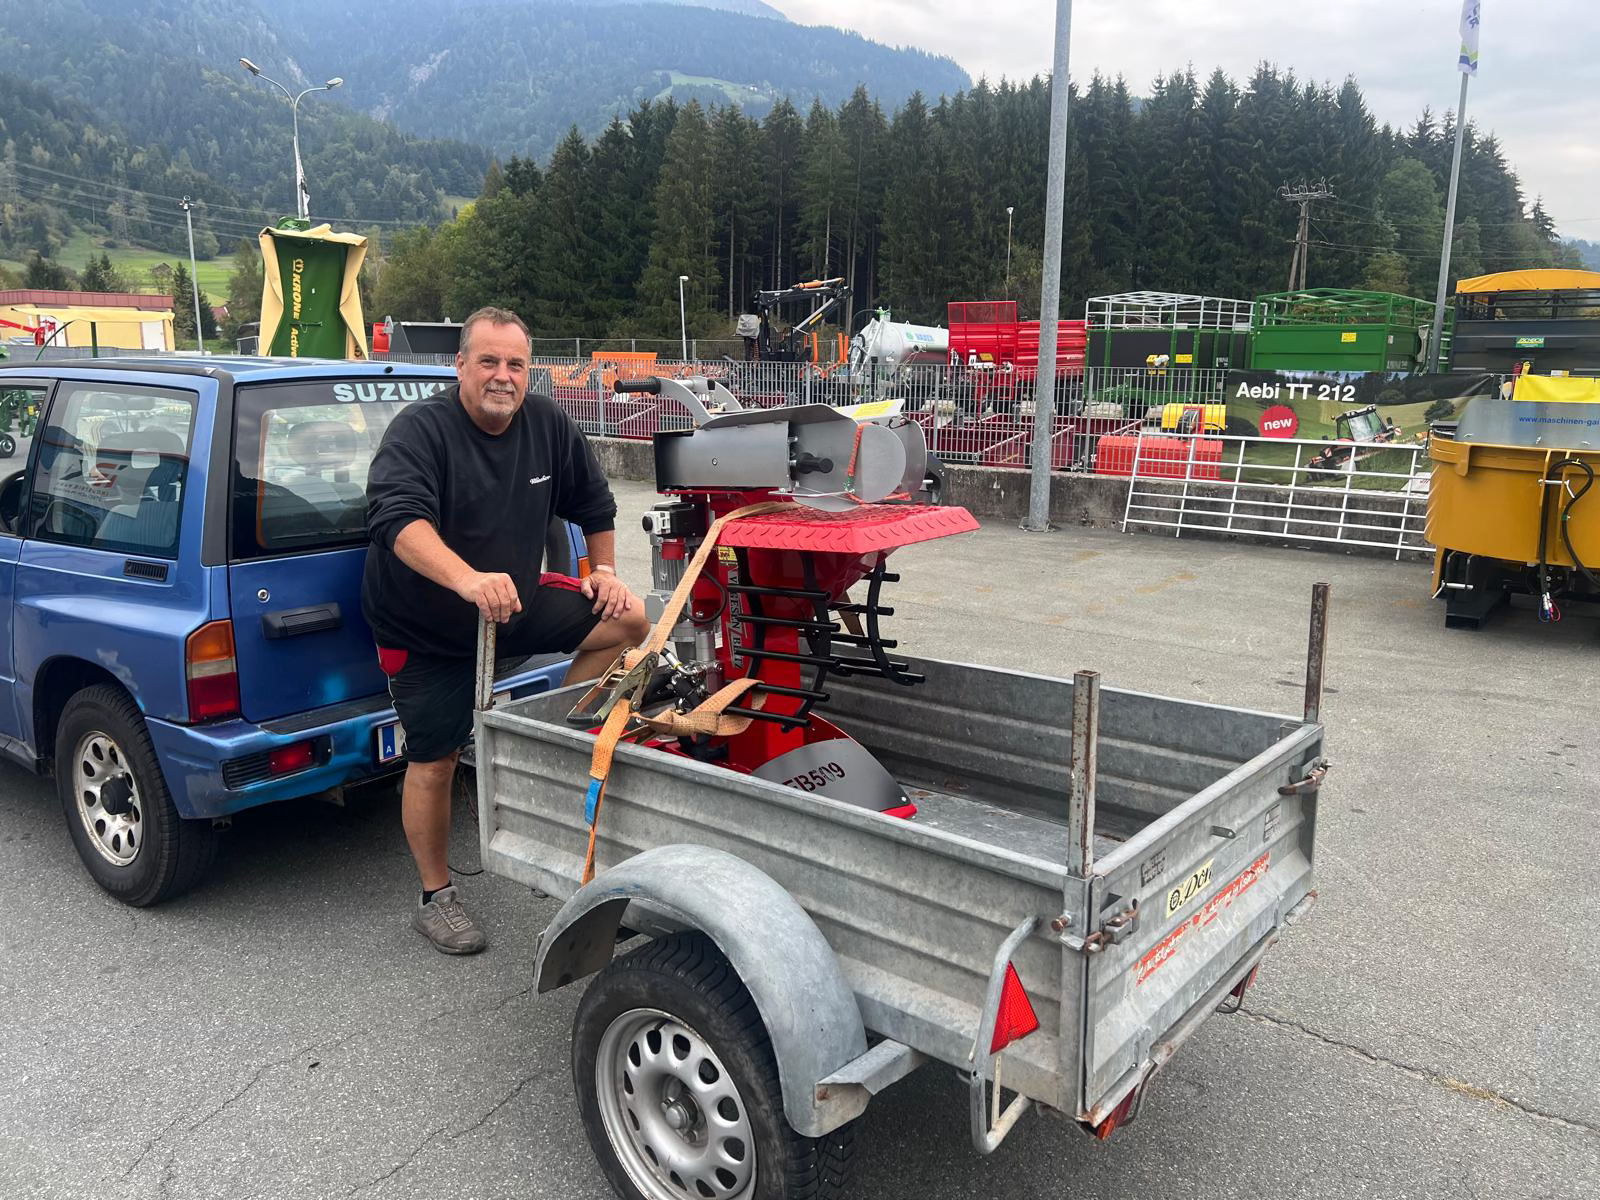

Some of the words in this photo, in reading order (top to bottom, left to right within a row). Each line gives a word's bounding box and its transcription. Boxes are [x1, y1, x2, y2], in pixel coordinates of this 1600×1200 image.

[293, 273, 302, 320] KRONE
[290, 328, 299, 358] Active
[1236, 381, 1280, 399] Aebi
[1286, 383, 1313, 400] TT
[1317, 384, 1356, 402] 212
[1263, 418, 1293, 431] new
[386, 745, 393, 754] A
